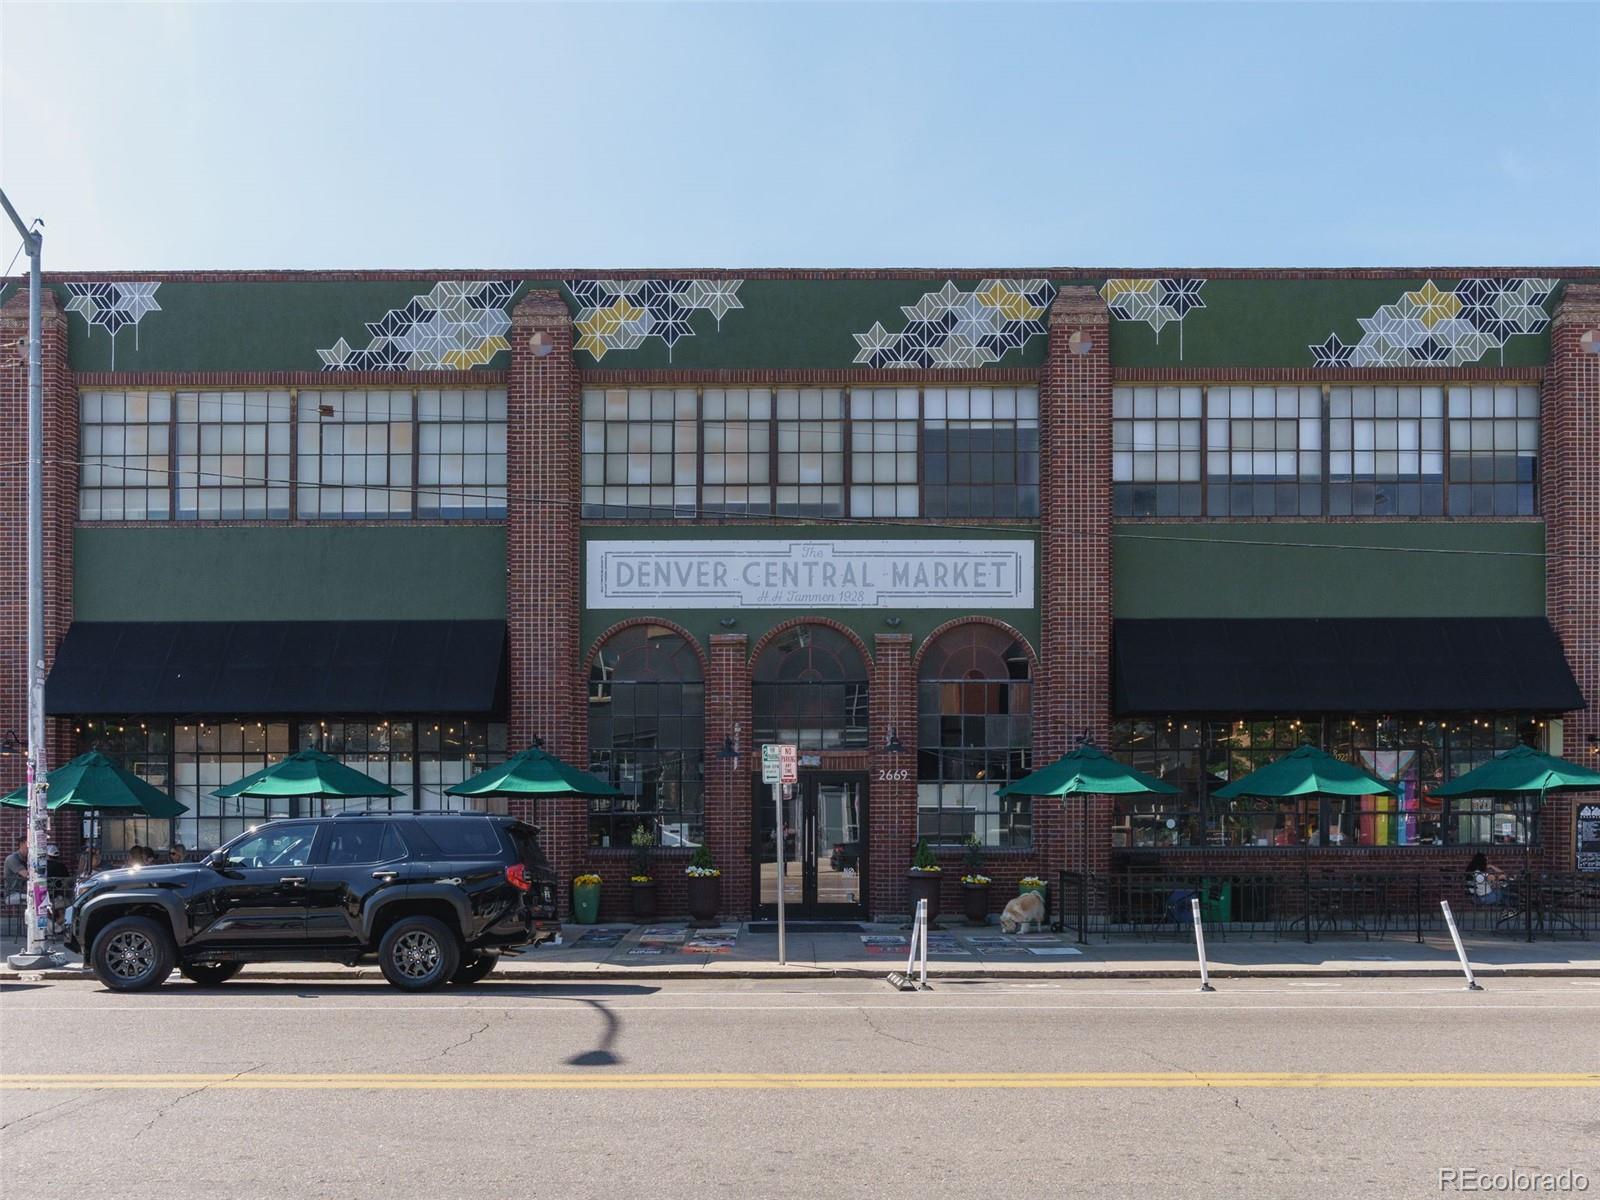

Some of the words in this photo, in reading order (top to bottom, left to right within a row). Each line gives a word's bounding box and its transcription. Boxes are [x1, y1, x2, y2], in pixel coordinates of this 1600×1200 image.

[801, 546, 824, 559] The
[616, 561, 728, 588] DENVER
[742, 561, 875, 588] CENTRAL
[892, 561, 1008, 588] MARKET
[839, 590, 865, 602] 1928
[879, 769, 908, 781] 2669
